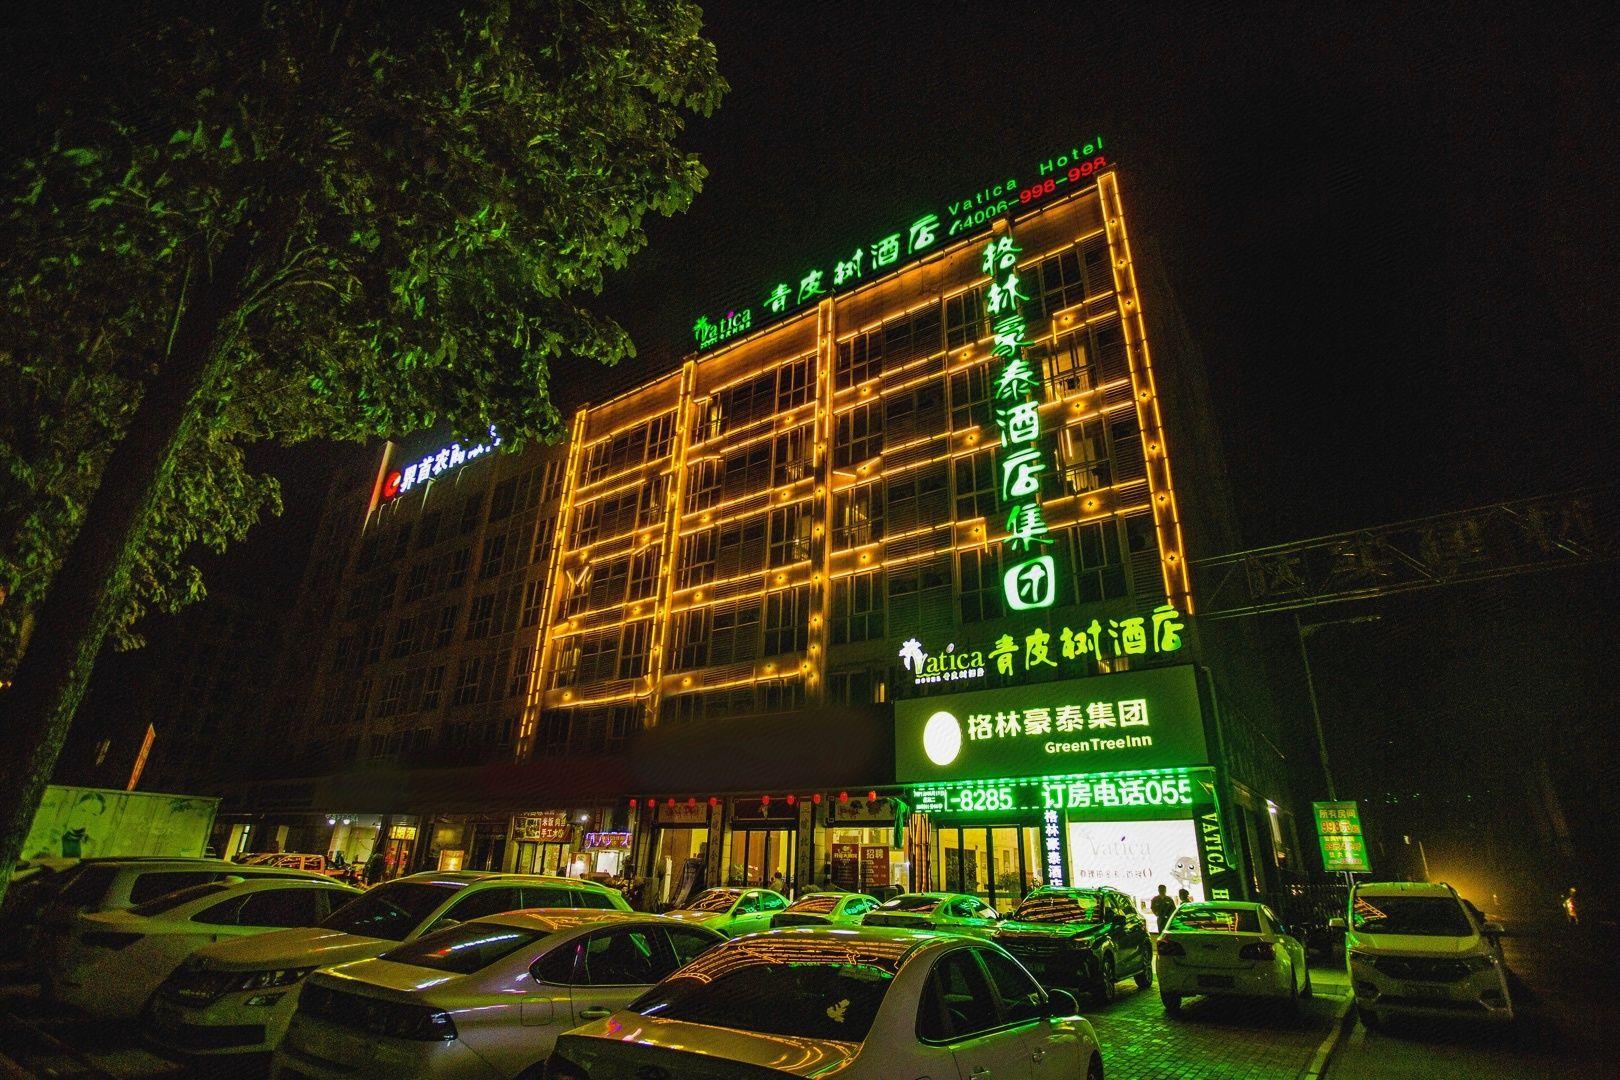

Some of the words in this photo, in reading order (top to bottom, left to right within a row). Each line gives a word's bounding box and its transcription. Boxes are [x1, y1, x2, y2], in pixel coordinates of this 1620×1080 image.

[948, 178, 1017, 216] Vatica
[1039, 136, 1104, 175] Hotel
[763, 213, 941, 313] 青皮树酒店
[982, 236, 1056, 611] 格林豪泰酒店集团
[988, 604, 1185, 677] 青皮树酒店
[967, 698, 1150, 741] 格林豪泰集团
[1042, 778, 1193, 809] 订房电话055
[1201, 812, 1226, 876] VATICA
